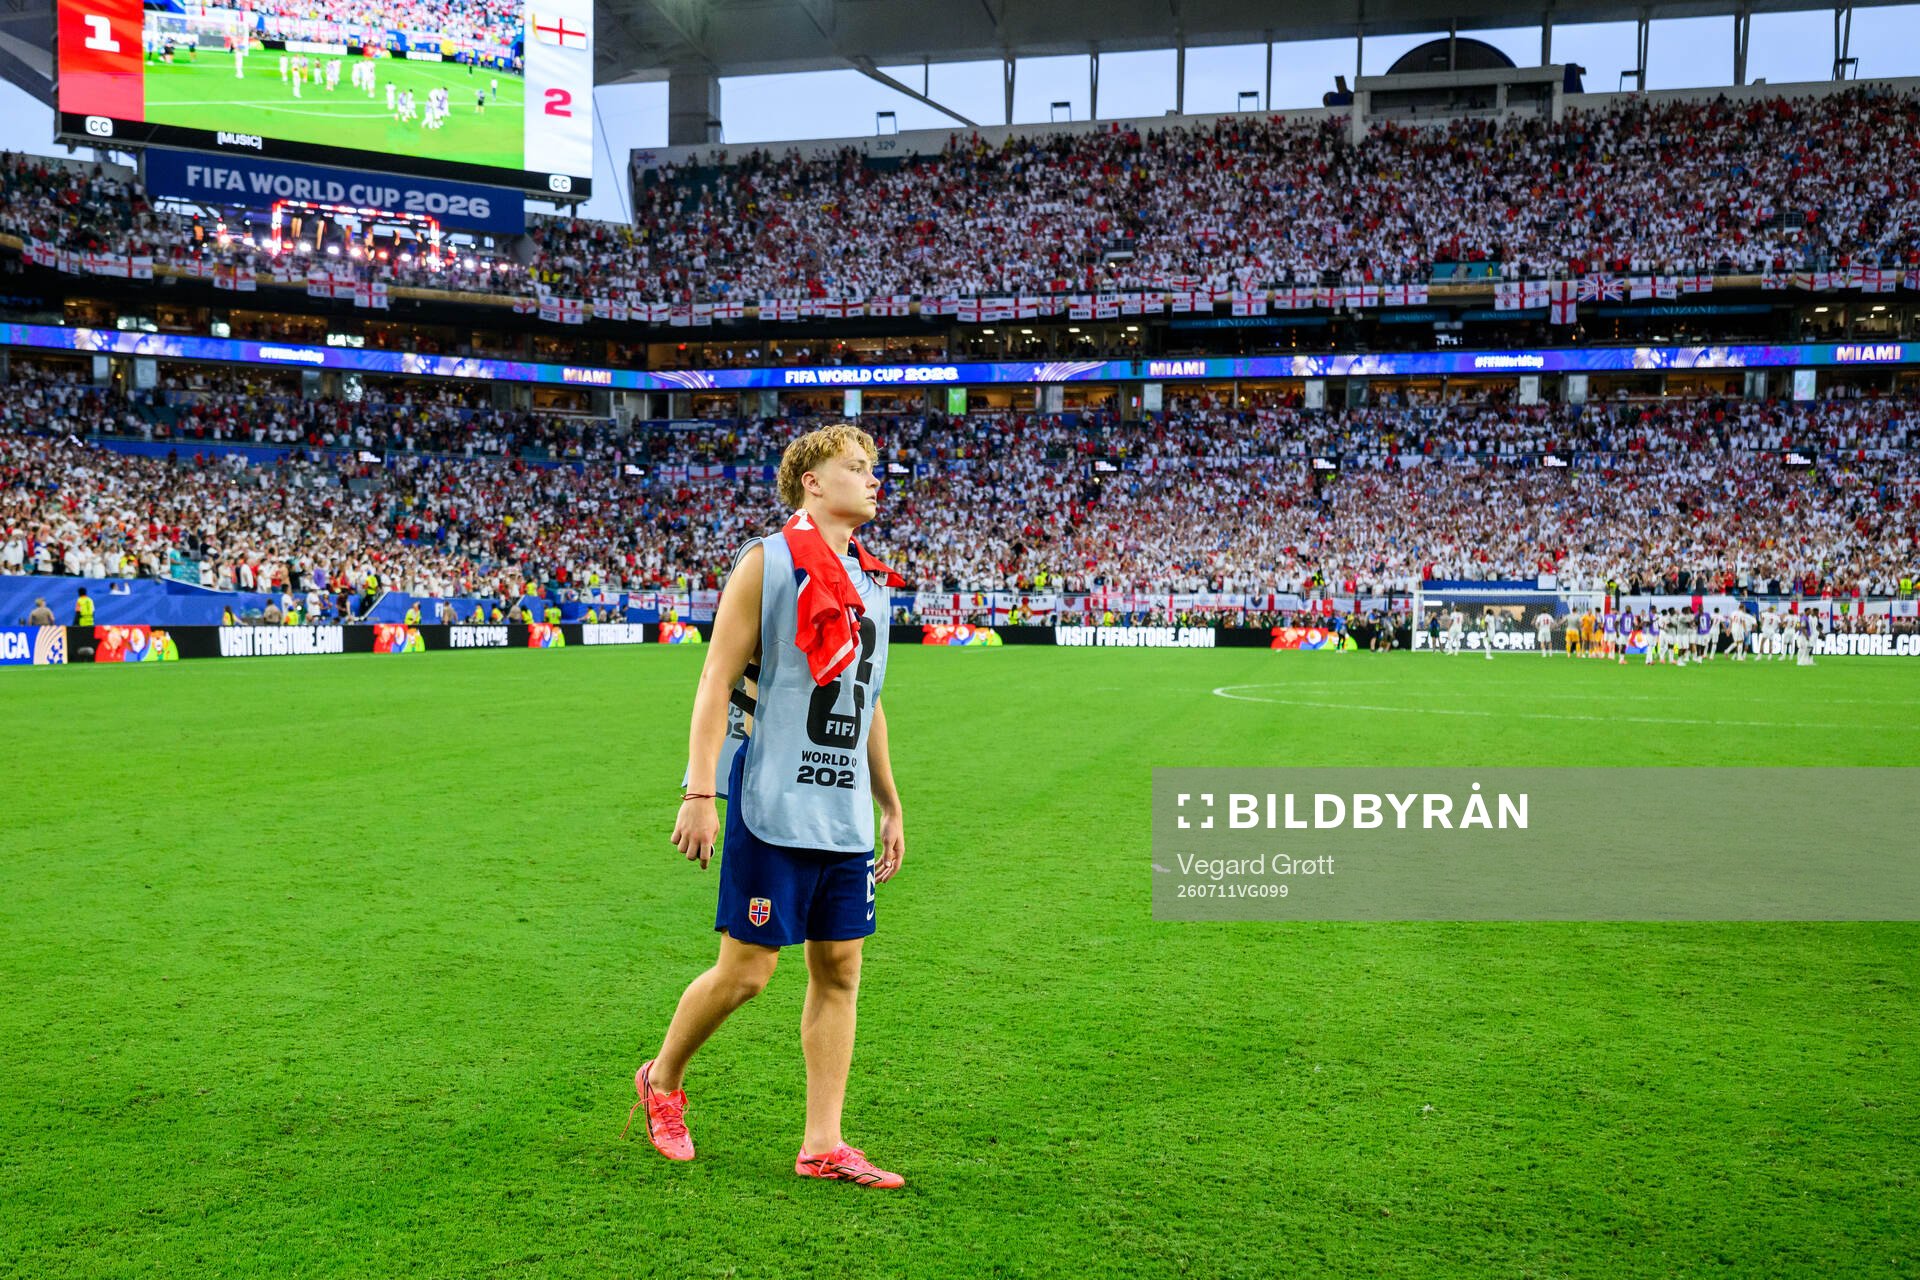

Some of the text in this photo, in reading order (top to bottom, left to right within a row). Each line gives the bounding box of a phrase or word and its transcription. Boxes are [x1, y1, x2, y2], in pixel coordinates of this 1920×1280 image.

[84, 14, 120, 53] 1
[544, 88, 572, 118] 2
[88, 118, 111, 134] CC
[217, 131, 263, 150] [MUSIC]
[186, 165, 491, 219] FIFA WORLD CUP 2026
[551, 176, 569, 191] CC
[1836, 345, 1901, 361] MIAMI
[563, 368, 612, 384] MIAMI
[785, 366, 959, 384] FIFA WORLD CUP 2026
[1150, 361, 1206, 376] MIAMI
[219, 625, 254, 657] VISIT
[449, 626, 476, 648] FIFA
[1054, 625, 1216, 648] VISIT FIFASTORE.COM
[801, 749, 840, 767] WORLD
[796, 764, 856, 791] 202
